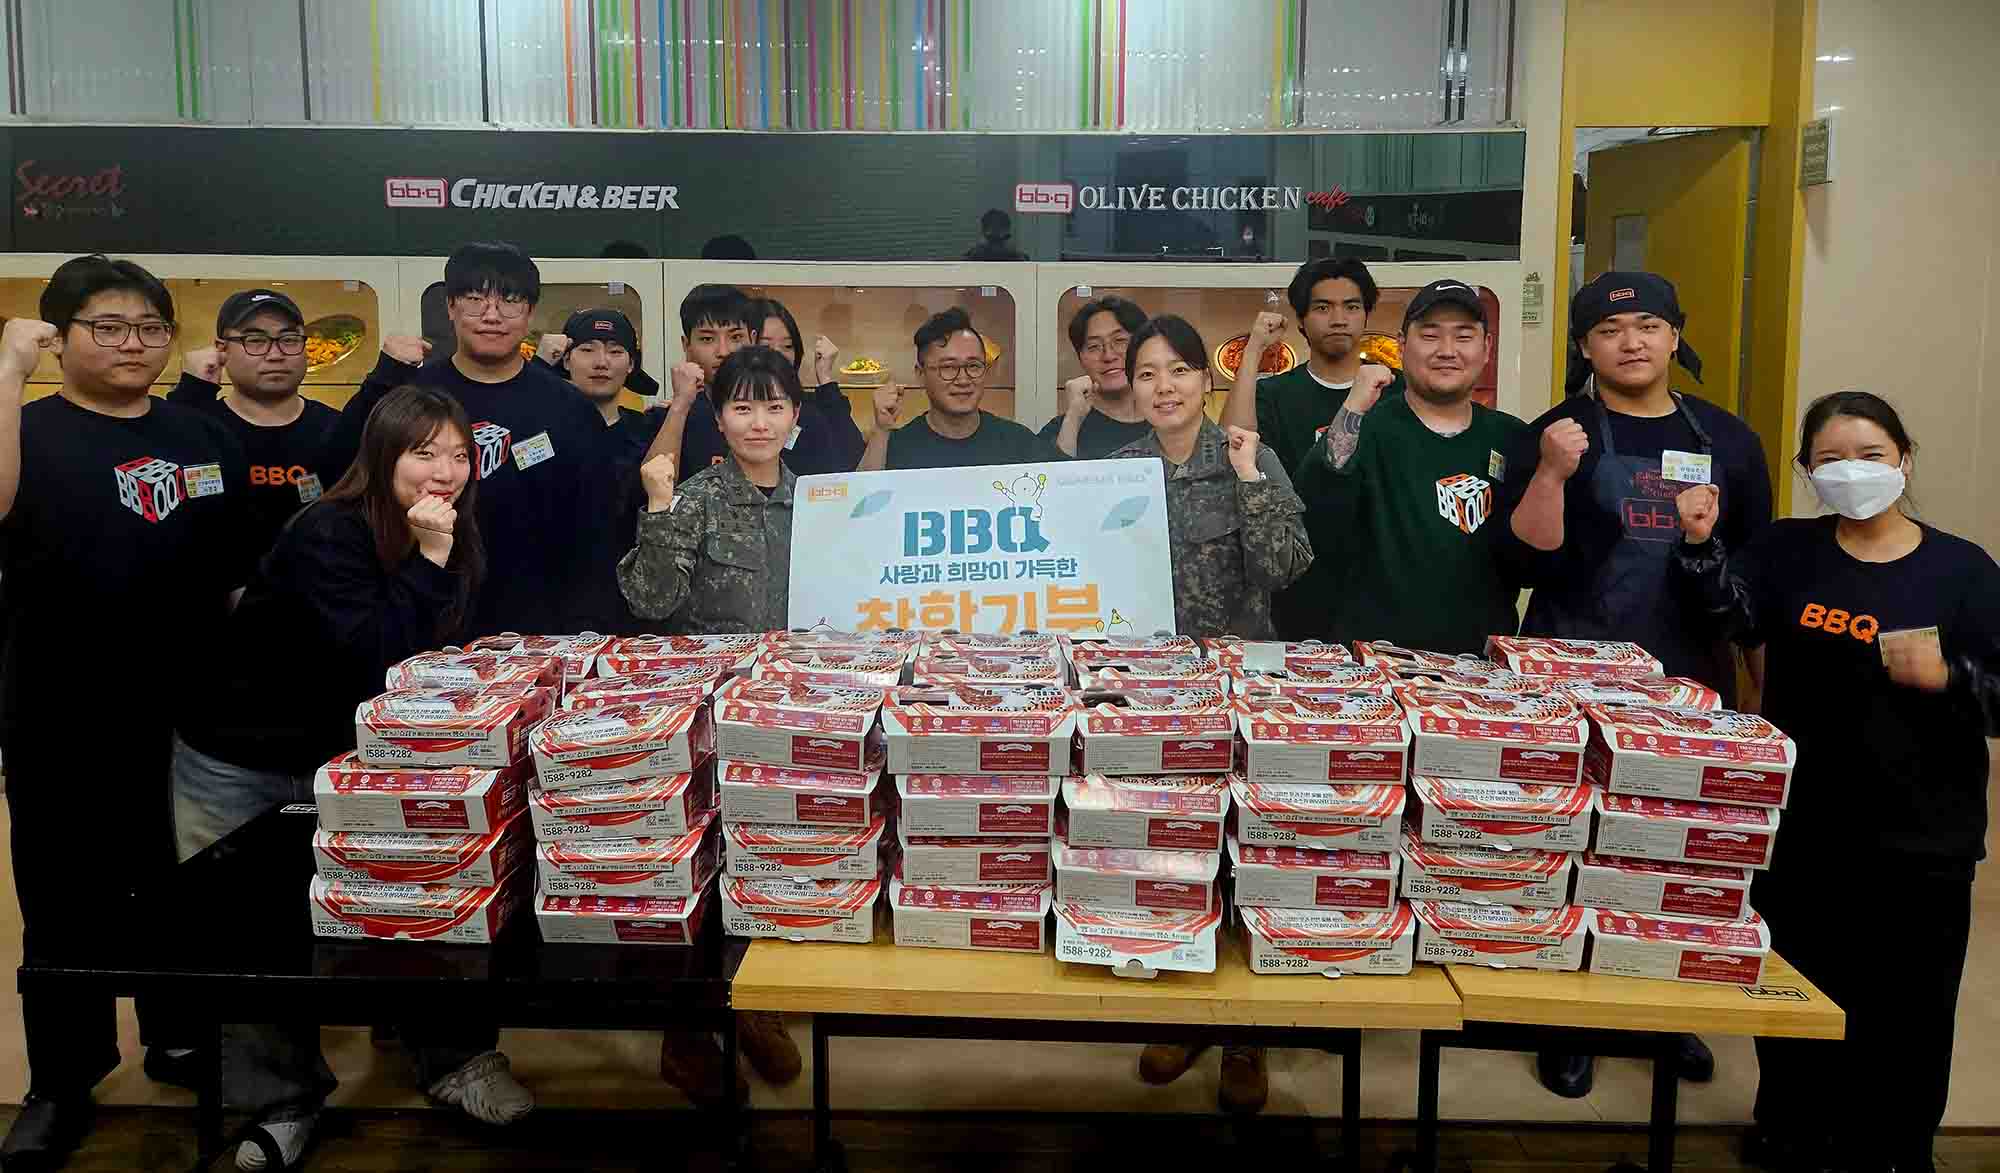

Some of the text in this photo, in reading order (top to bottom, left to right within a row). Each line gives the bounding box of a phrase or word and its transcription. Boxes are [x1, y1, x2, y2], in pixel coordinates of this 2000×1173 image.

[1079, 184, 1166, 211] OLIVE
[1172, 185, 1301, 211] CHICKEN
[903, 506, 1050, 557] BBQ
[879, 557, 1078, 585] 사랑과 희망이 가득한
[1800, 603, 1880, 643] BBQ
[365, 748, 413, 759] 1588-9282
[543, 769, 593, 784] 1588-9282
[542, 824, 591, 836] 1588-9282
[1247, 830, 1297, 841] 1588-9282
[1431, 828, 1482, 840] 1588-9282
[734, 862, 783, 873] 1588-9282
[323, 870, 370, 881] 1588-9282
[548, 881, 598, 892] 1588-9282
[1409, 883, 1461, 896] 1588-9282
[317, 925, 365, 936] 1588-9282
[730, 922, 778, 933] 1588-9282
[1062, 945, 1113, 959] 1588-9282
[1424, 946, 1475, 958] 1588-9282
[1259, 958, 1310, 969] 1588-9282
